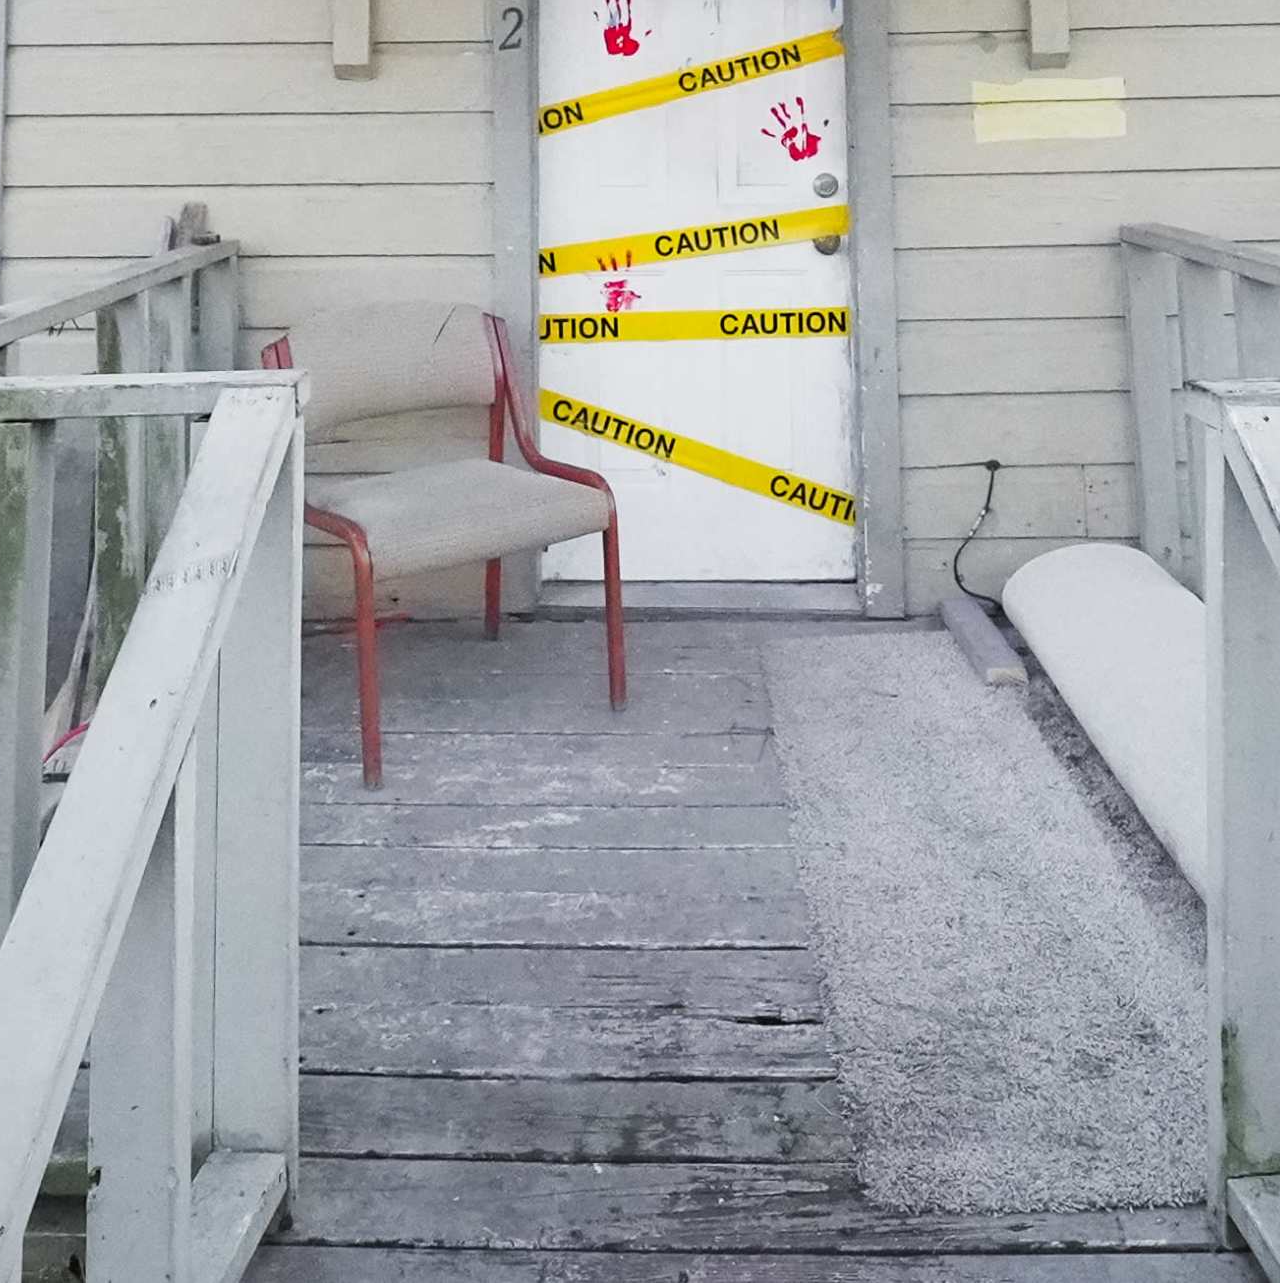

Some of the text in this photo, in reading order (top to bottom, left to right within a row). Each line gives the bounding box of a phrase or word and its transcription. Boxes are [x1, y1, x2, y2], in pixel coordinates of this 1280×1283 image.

[677, 44, 802, 93] CAUTION
[654, 219, 780, 257] CAUTION
[719, 310, 847, 335] CAUTION
[552, 399, 856, 522] CAUTION CAUTI
